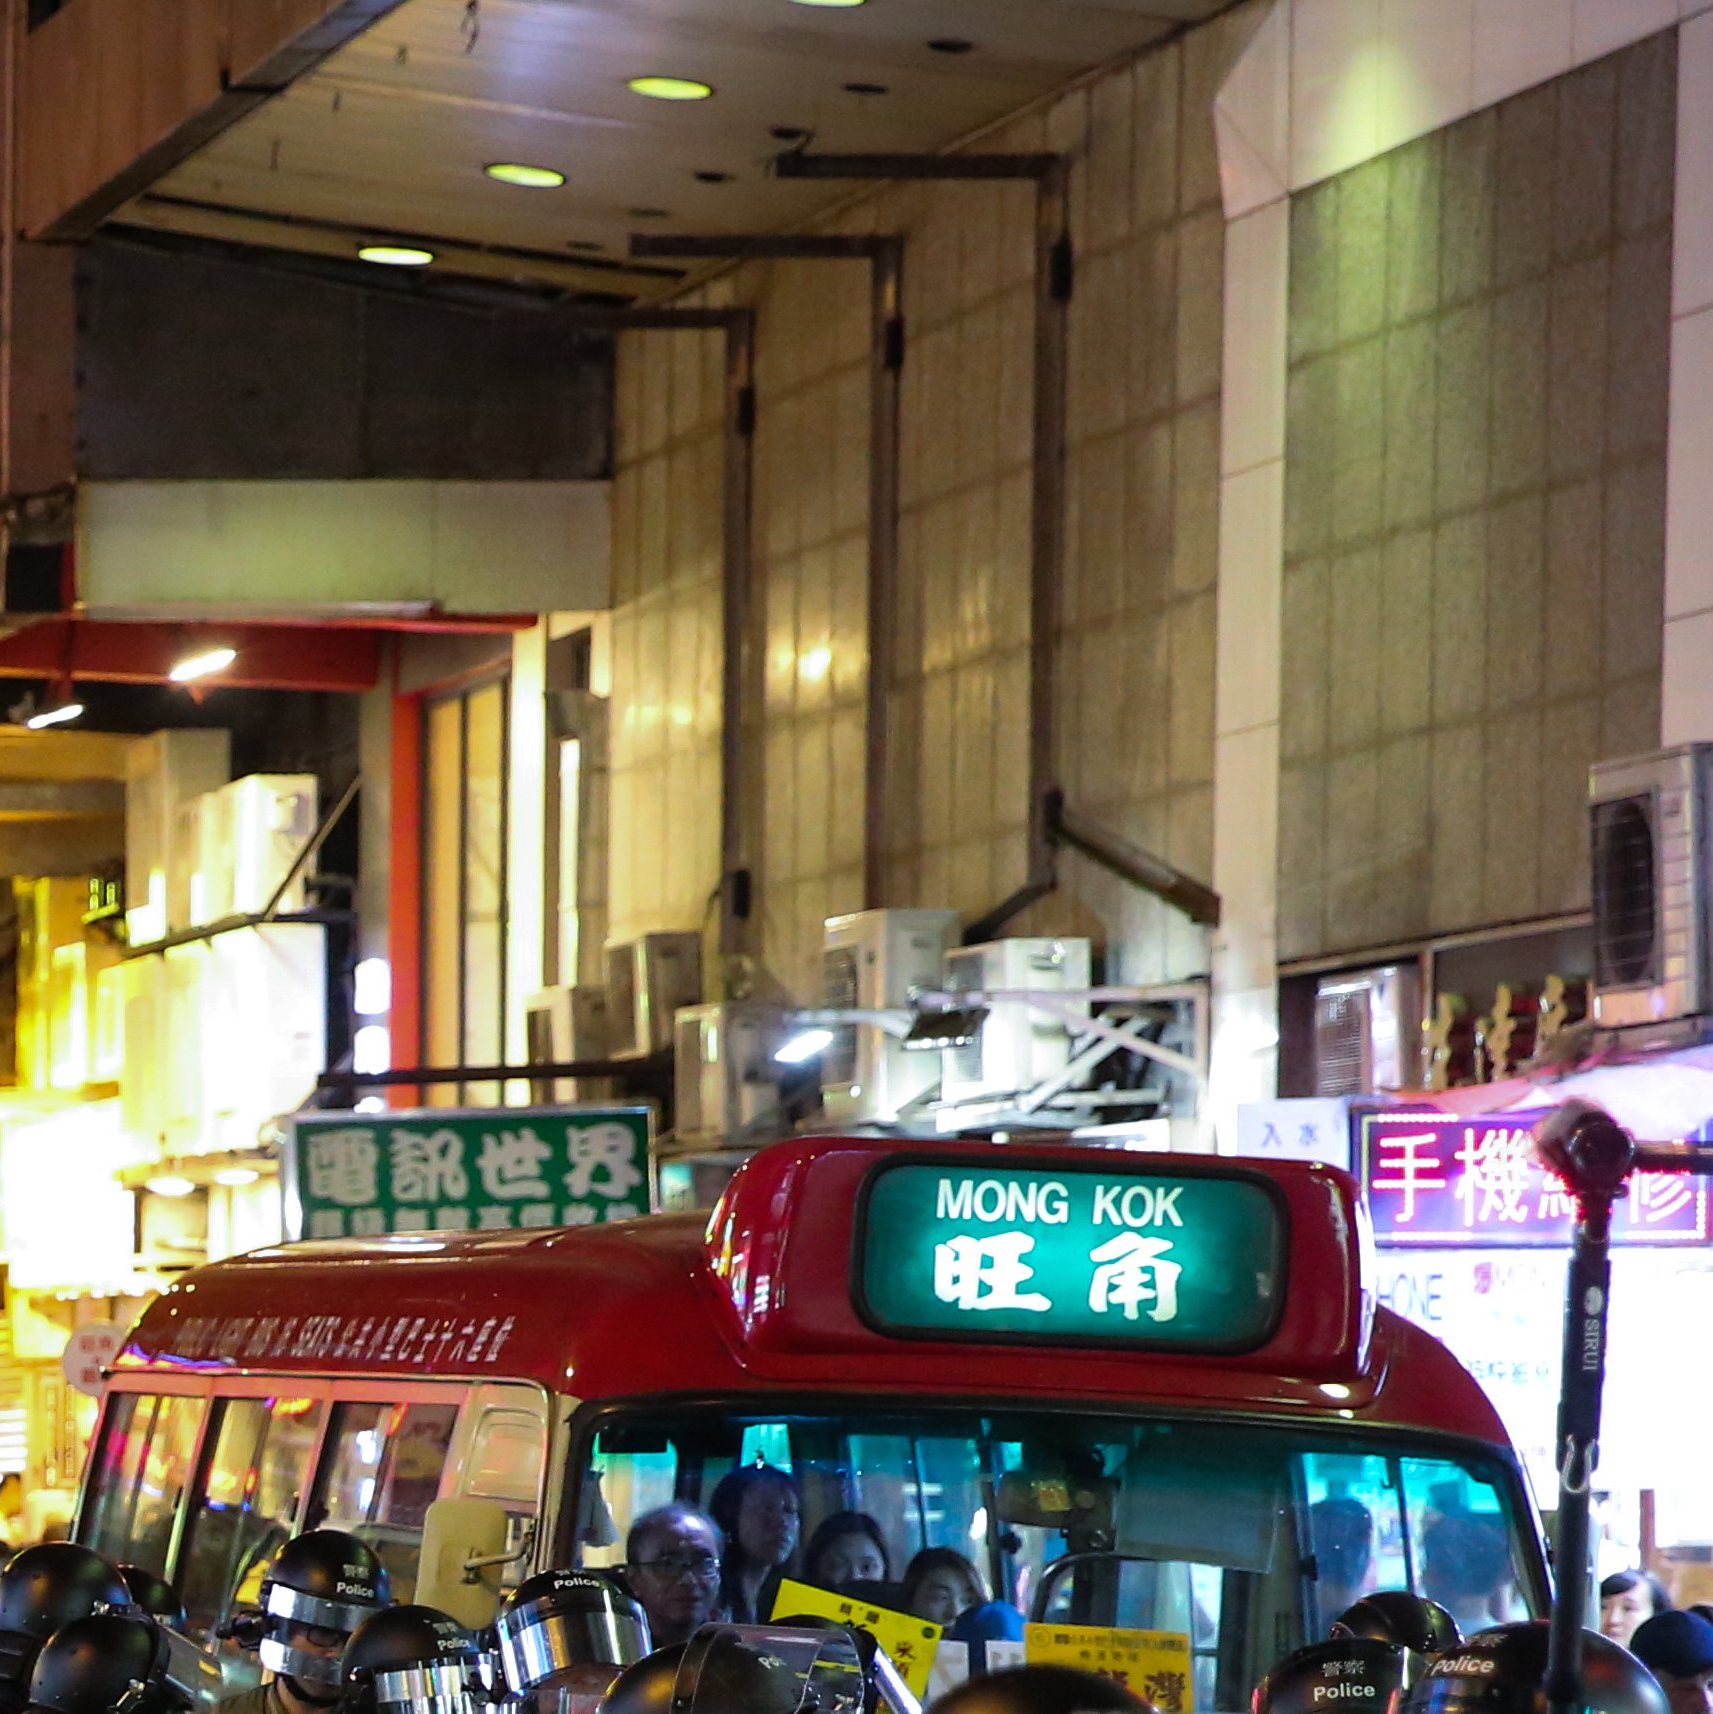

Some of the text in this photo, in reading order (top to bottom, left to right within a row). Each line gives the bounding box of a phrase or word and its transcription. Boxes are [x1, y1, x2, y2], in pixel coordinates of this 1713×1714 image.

[1373, 1127, 1692, 1227] 手機修
[934, 1176, 1184, 1228] MONG KOK
[932, 1231, 1184, 1324] 旺角
[1376, 1272, 1443, 1321] HONE
[1582, 1319, 1601, 1372] SIRUI
[336, 1581, 375, 1599] Police
[553, 1576, 600, 1590] Police
[1430, 1654, 1495, 1677] Police
[1312, 1681, 1377, 1702] Police
